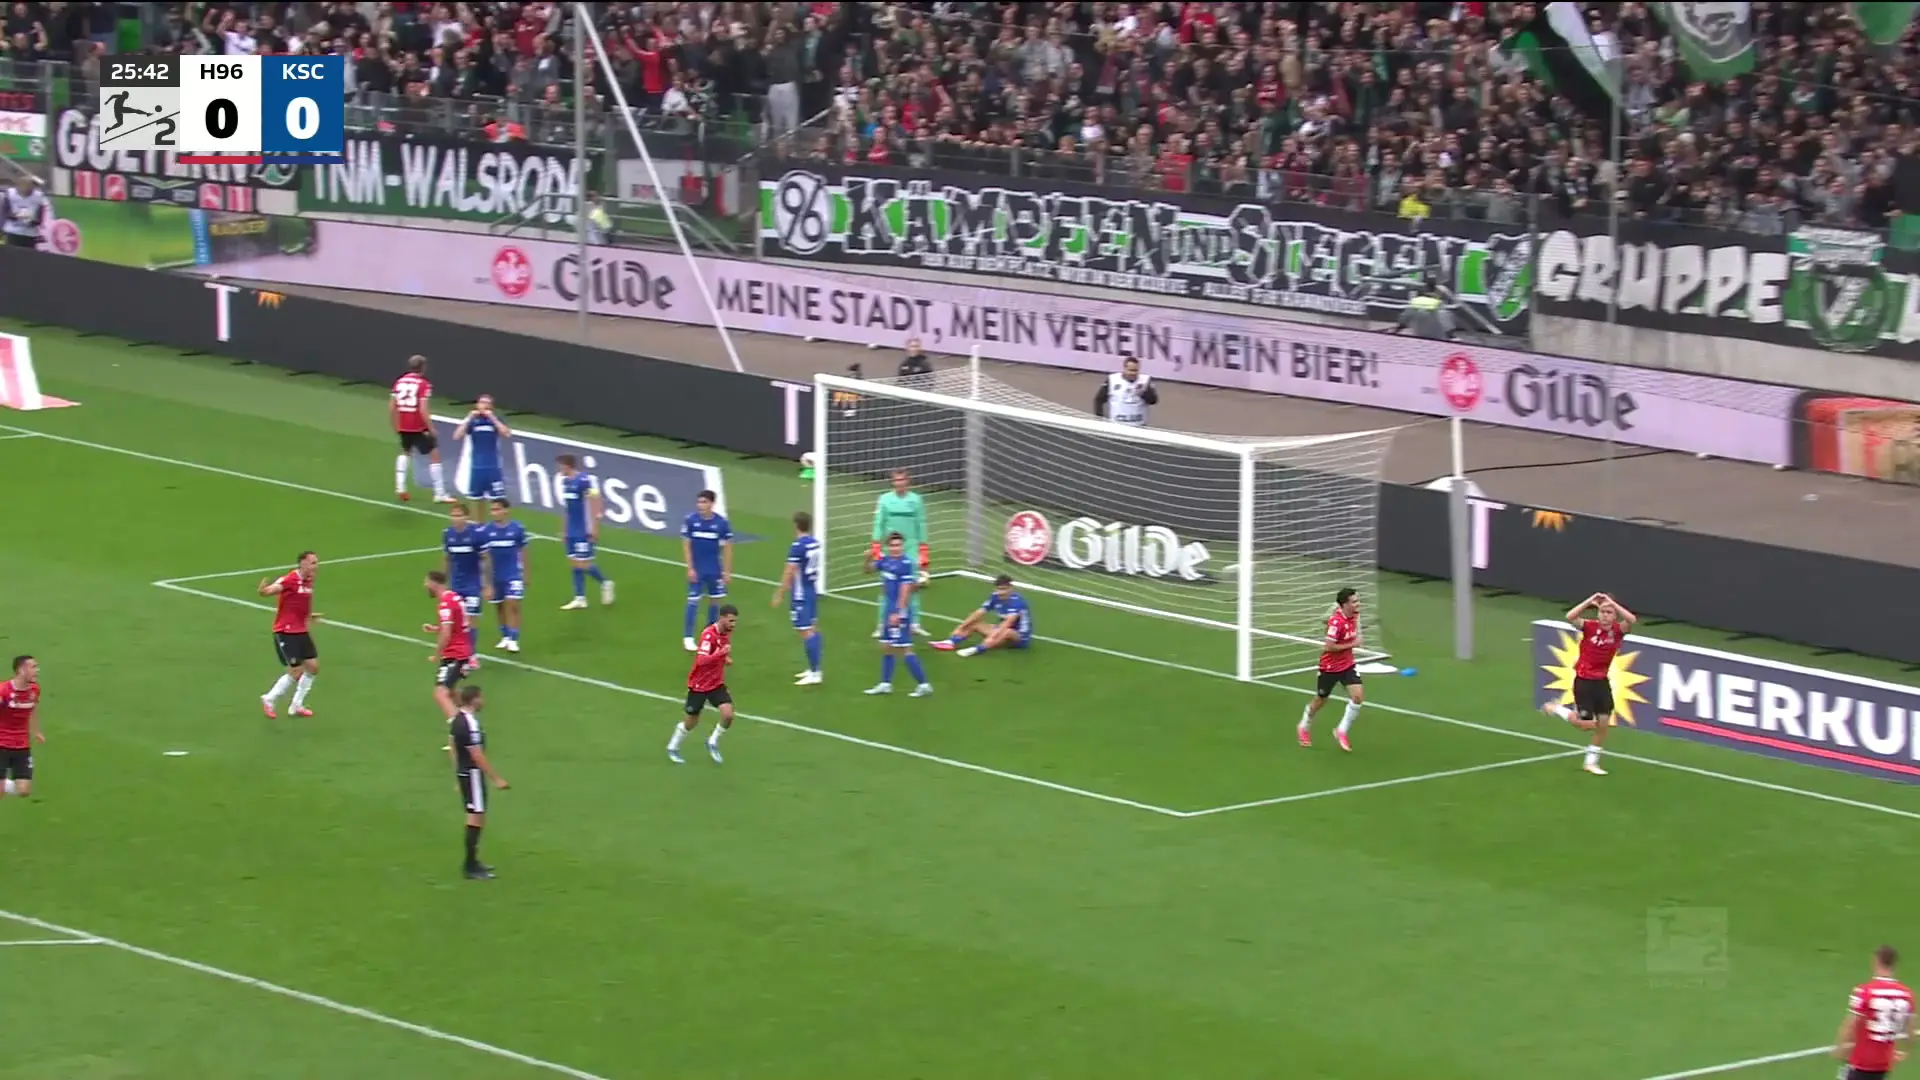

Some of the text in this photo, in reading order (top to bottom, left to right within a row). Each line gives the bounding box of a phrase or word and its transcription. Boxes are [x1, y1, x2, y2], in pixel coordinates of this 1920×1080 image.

[553, 253, 676, 311] Gilde
[1537, 230, 1789, 324] GRUPPE
[717, 278, 1380, 390] MEINE STADT, MEIN VEREIN, MEIN BIER!
[396, 383, 419, 406] 23
[1504, 363, 1640, 431] Gilde
[1057, 516, 1211, 580] Gilde
